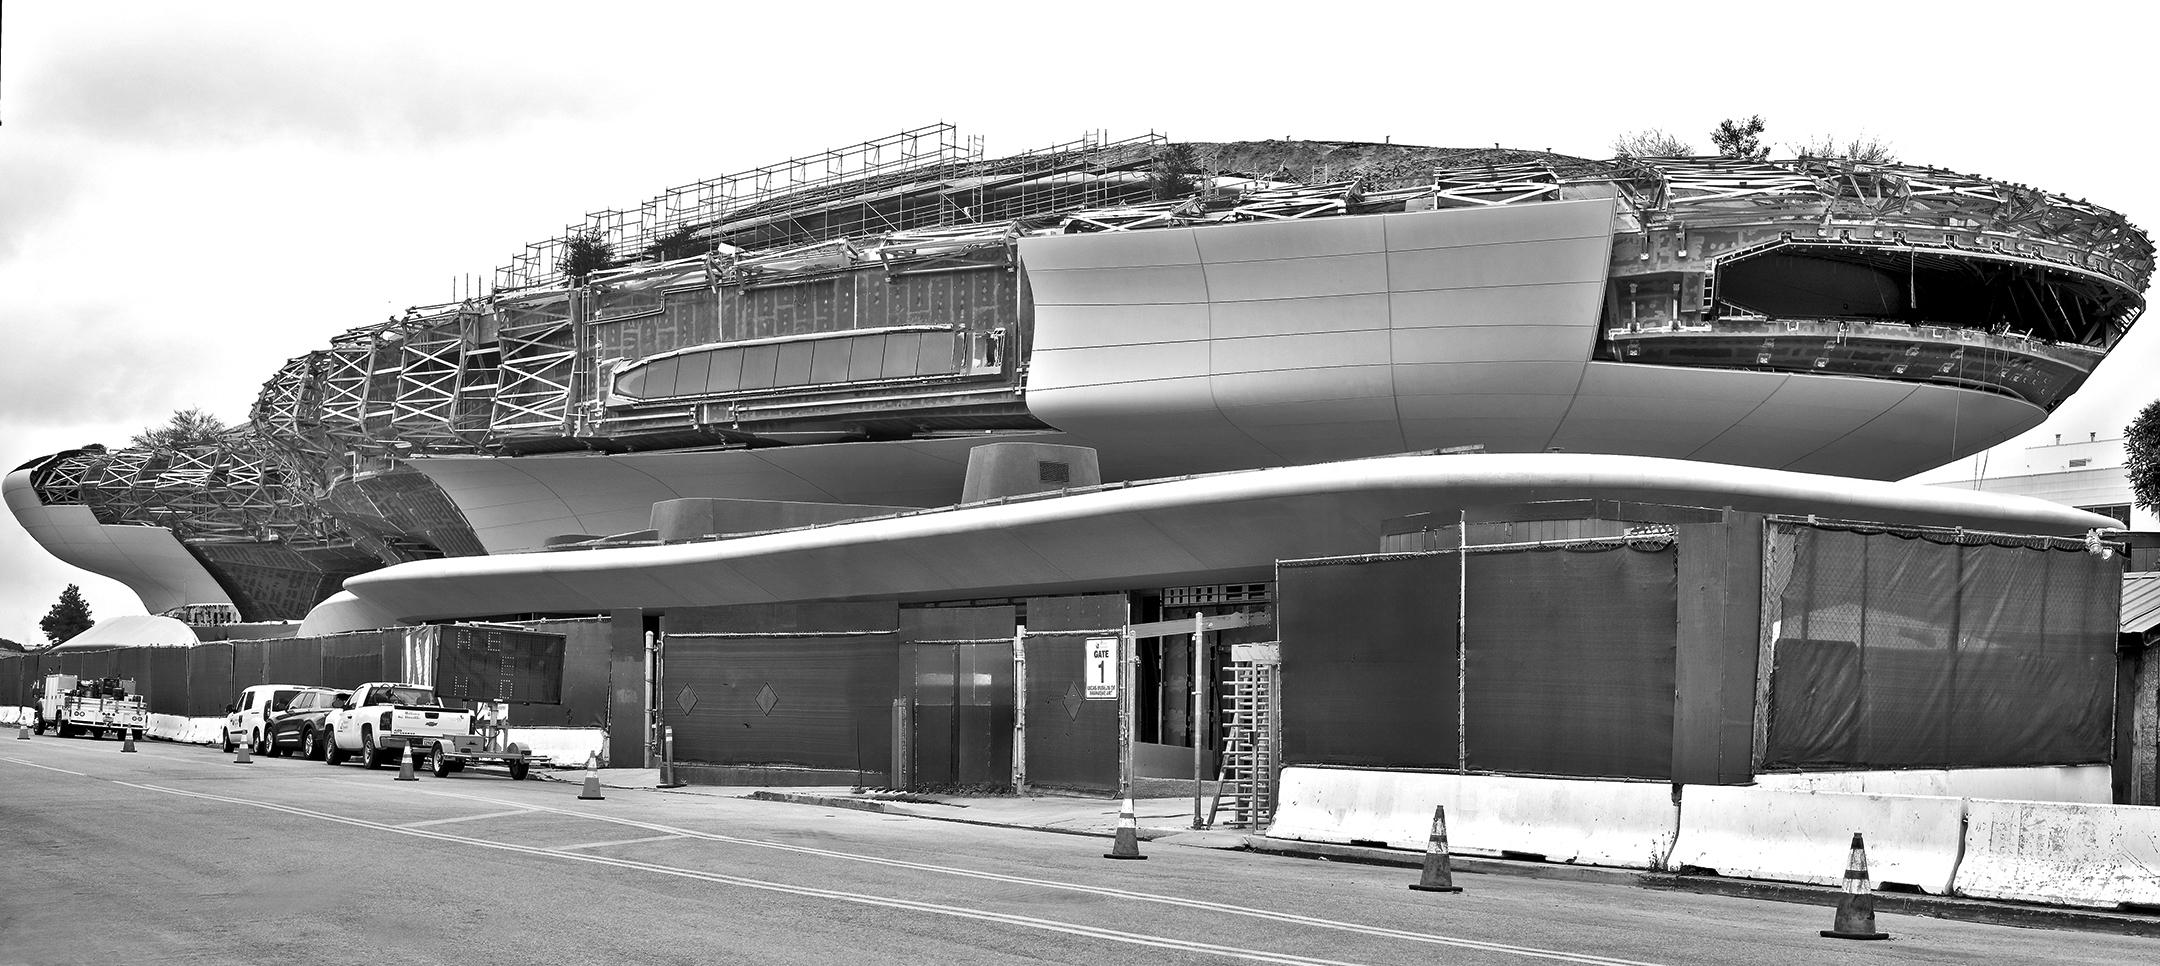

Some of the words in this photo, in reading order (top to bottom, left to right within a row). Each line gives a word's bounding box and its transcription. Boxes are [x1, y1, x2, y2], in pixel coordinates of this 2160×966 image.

[457, 629, 471, 650] A
[488, 631, 501, 652] E
[1093, 650, 1109, 658] GATE
[501, 656, 514, 676] E
[1098, 660, 1104, 683] 1
[454, 675, 468, 696] H
